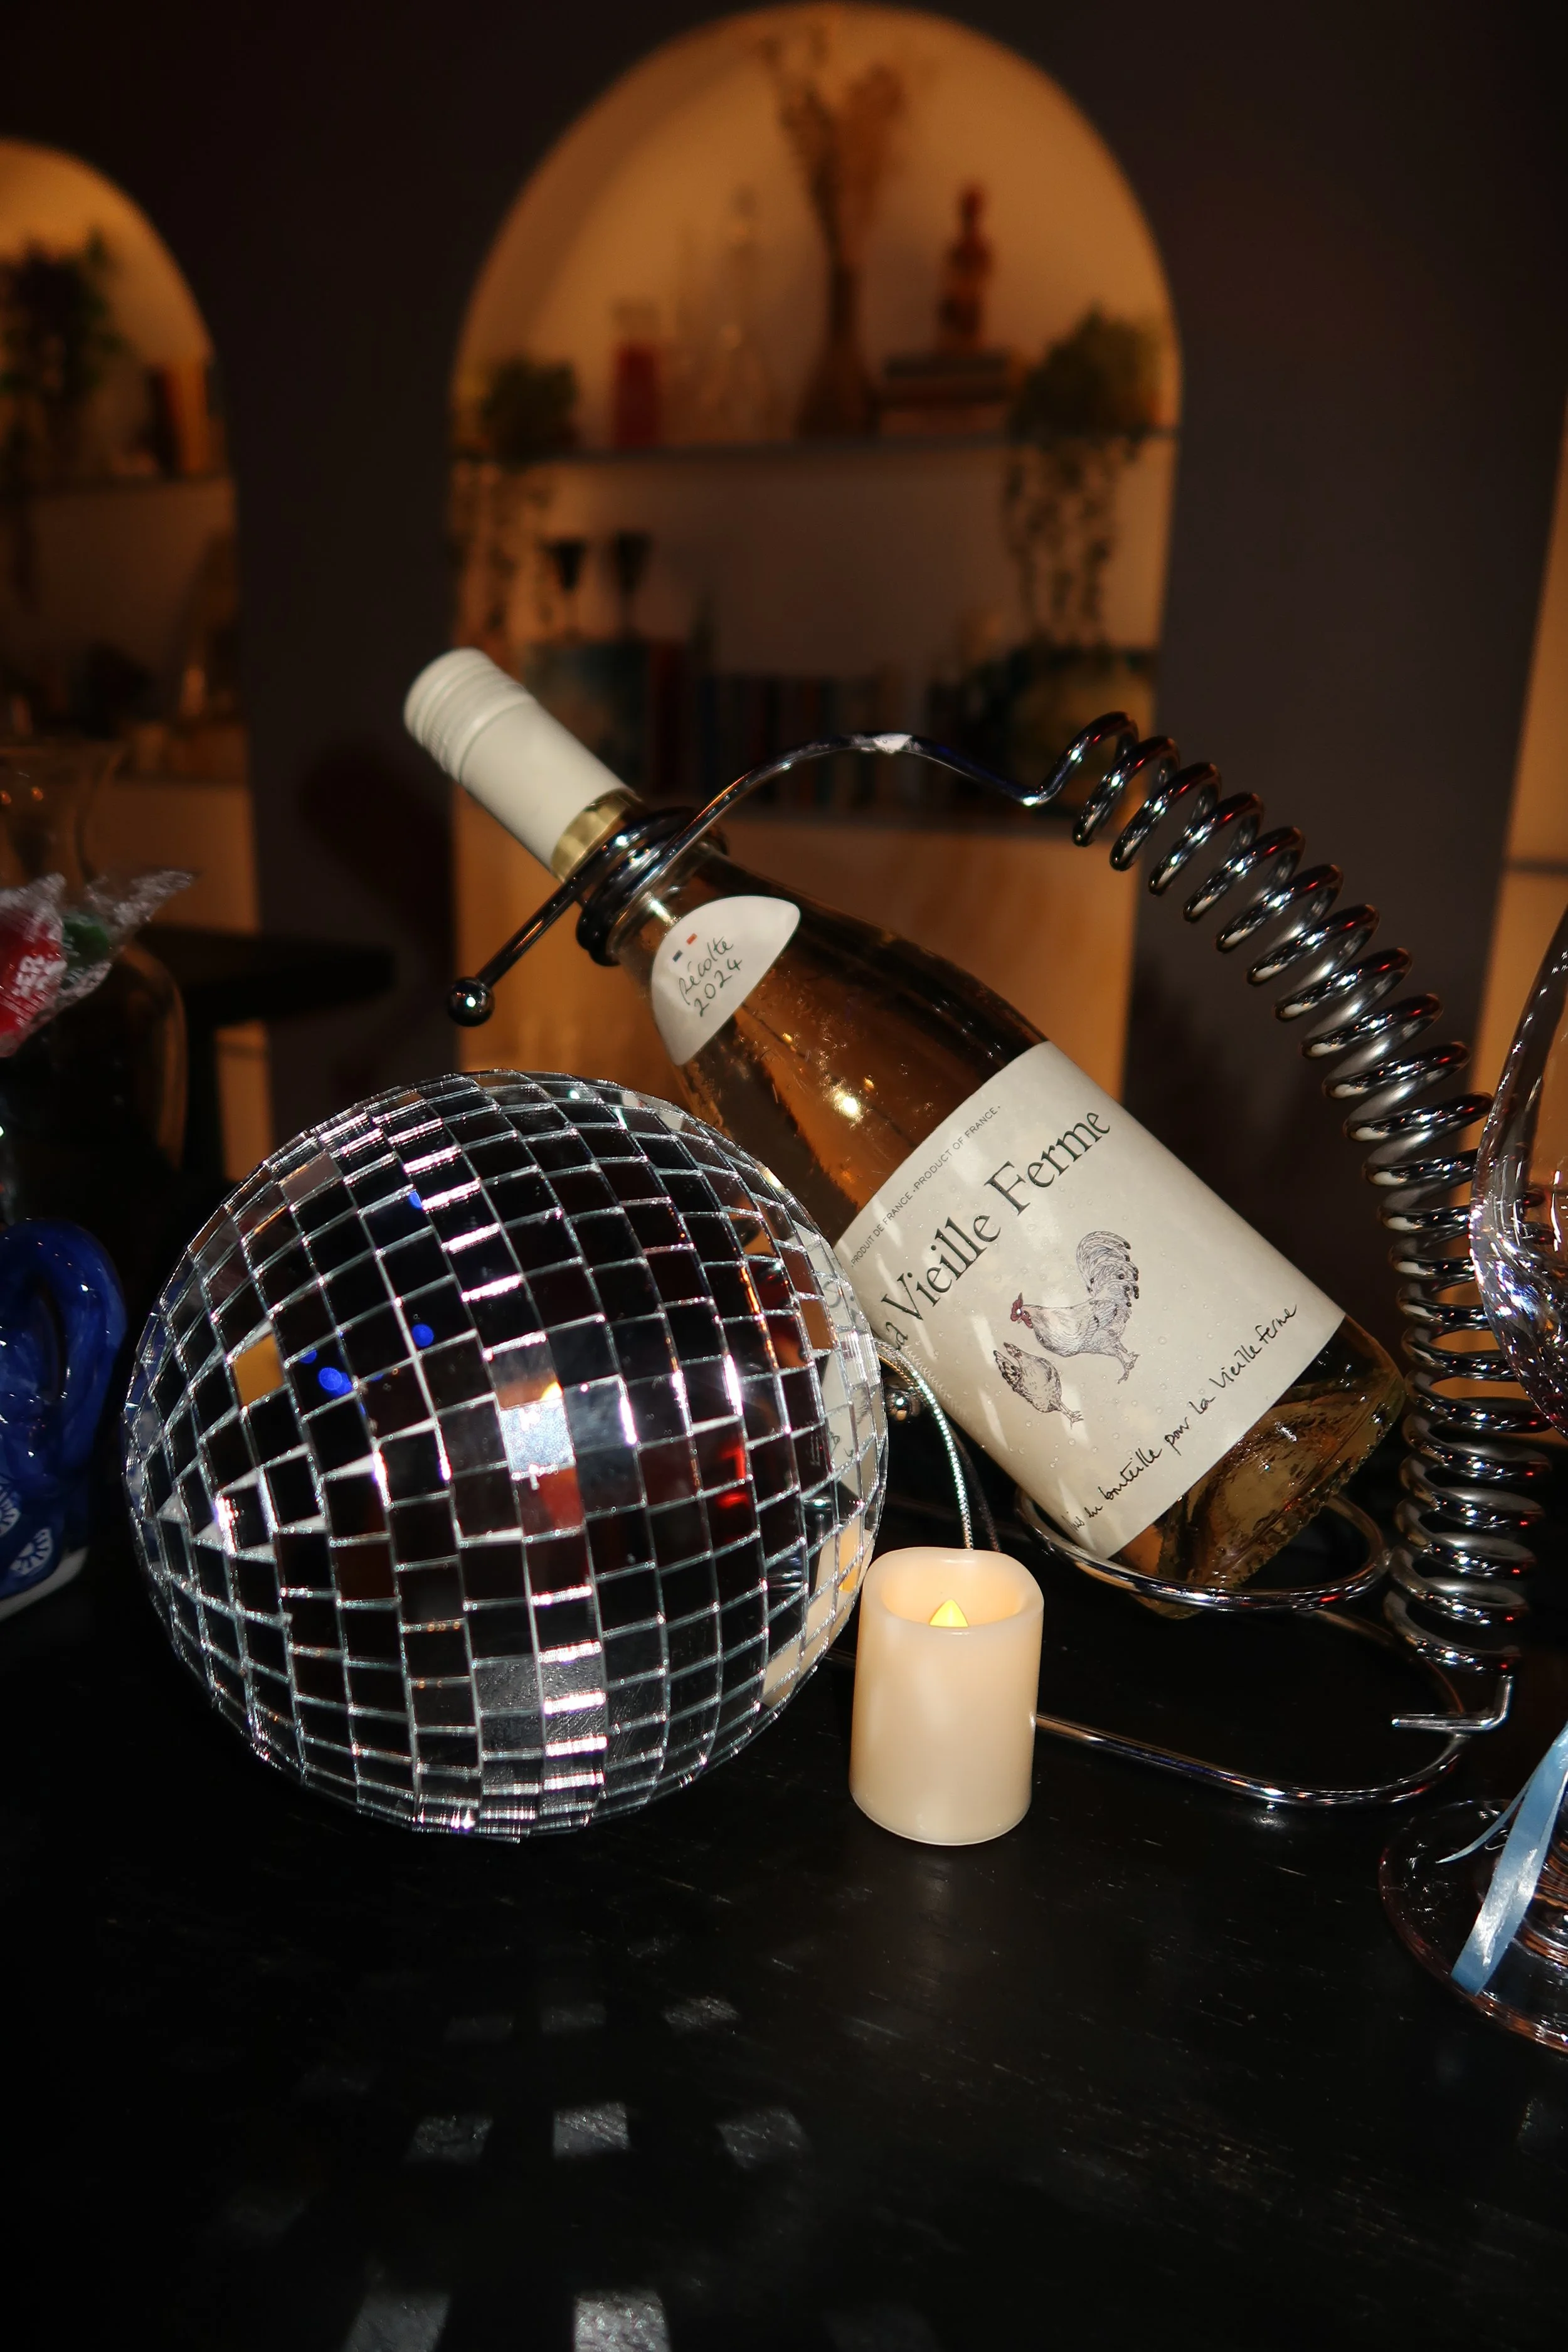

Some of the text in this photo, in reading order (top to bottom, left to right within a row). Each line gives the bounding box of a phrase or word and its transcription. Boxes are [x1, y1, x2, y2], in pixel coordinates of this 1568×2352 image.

[694, 959, 742, 1017] 2024
[874, 1224, 885, 1237] DE
[952, 1136, 964, 1150] OF
[881, 1112, 1110, 1350] a Vieille Ferme
[1098, 1448, 1162, 1500] bouteille
